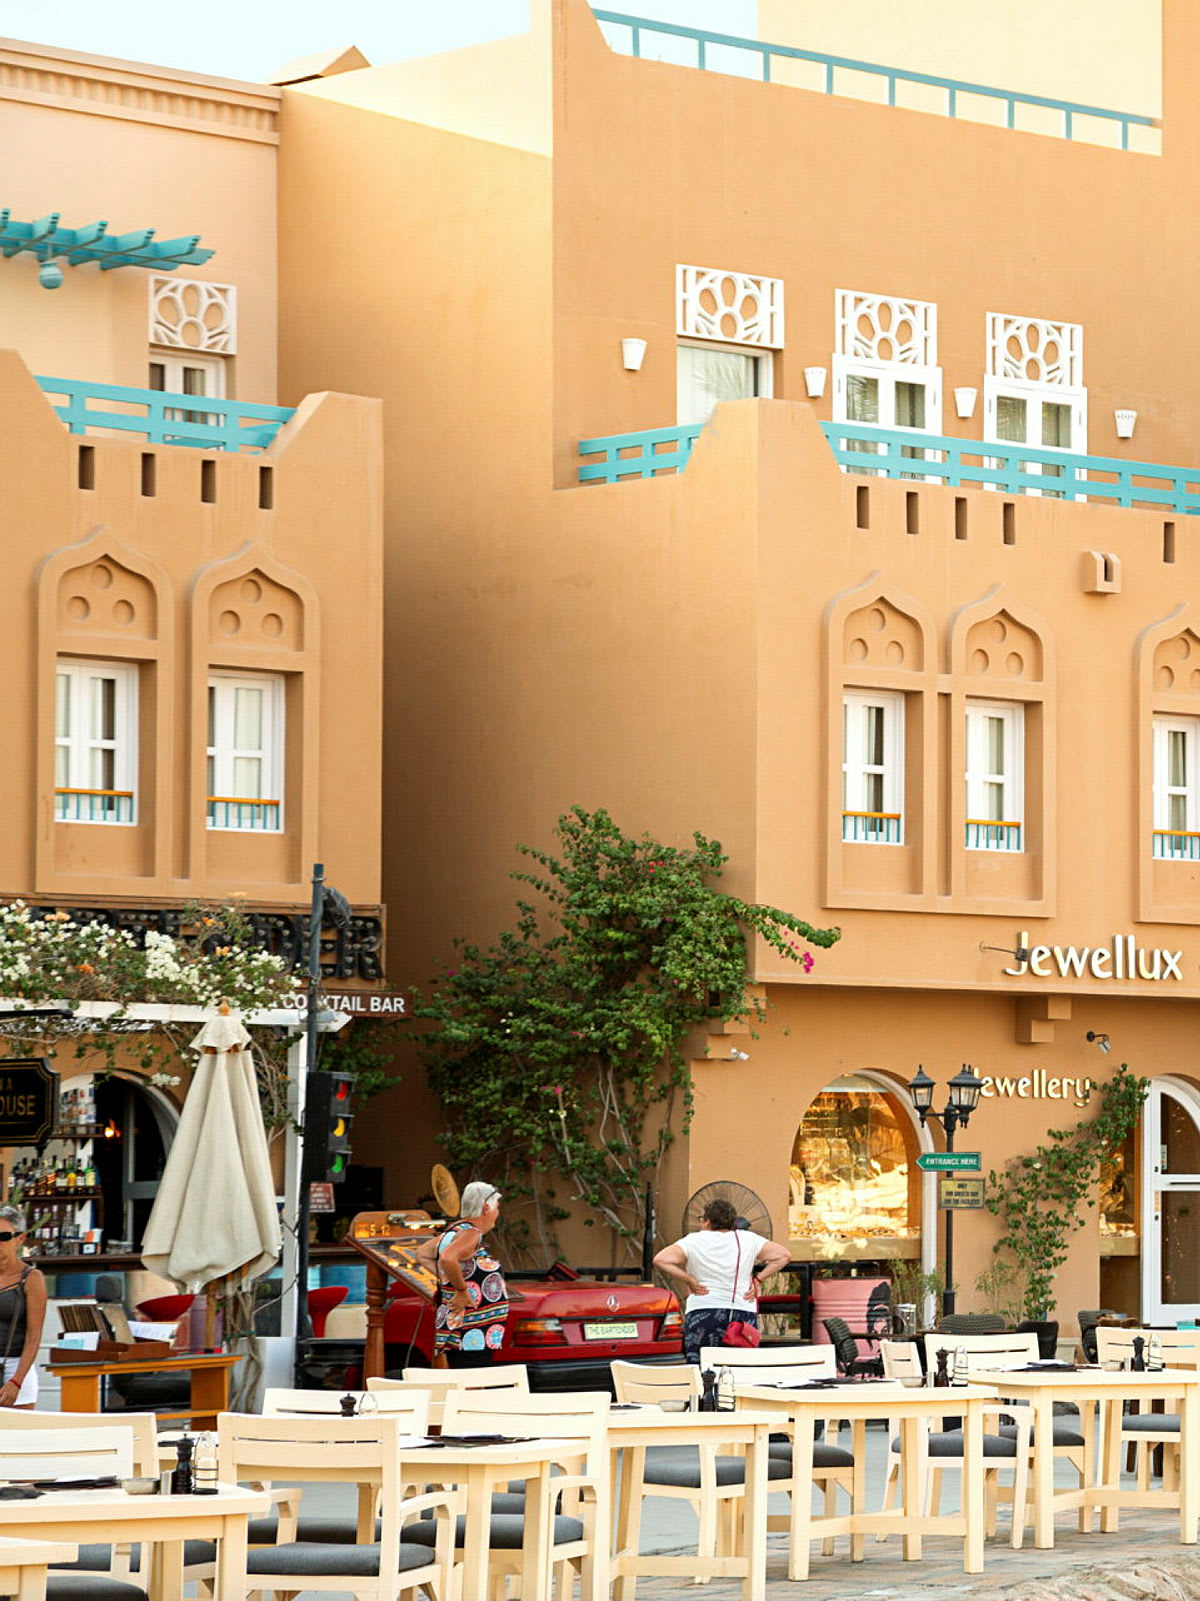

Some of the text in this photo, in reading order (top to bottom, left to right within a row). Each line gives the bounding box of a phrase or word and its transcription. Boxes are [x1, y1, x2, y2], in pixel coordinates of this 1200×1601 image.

[1002, 931, 1184, 981] Jewellux
[282, 993, 366, 1012] COKTAIL
[370, 996, 405, 1013] BAR
[974, 1068, 1092, 1107] ewellery
[926, 1157, 977, 1166] ENTRANCE HERE
